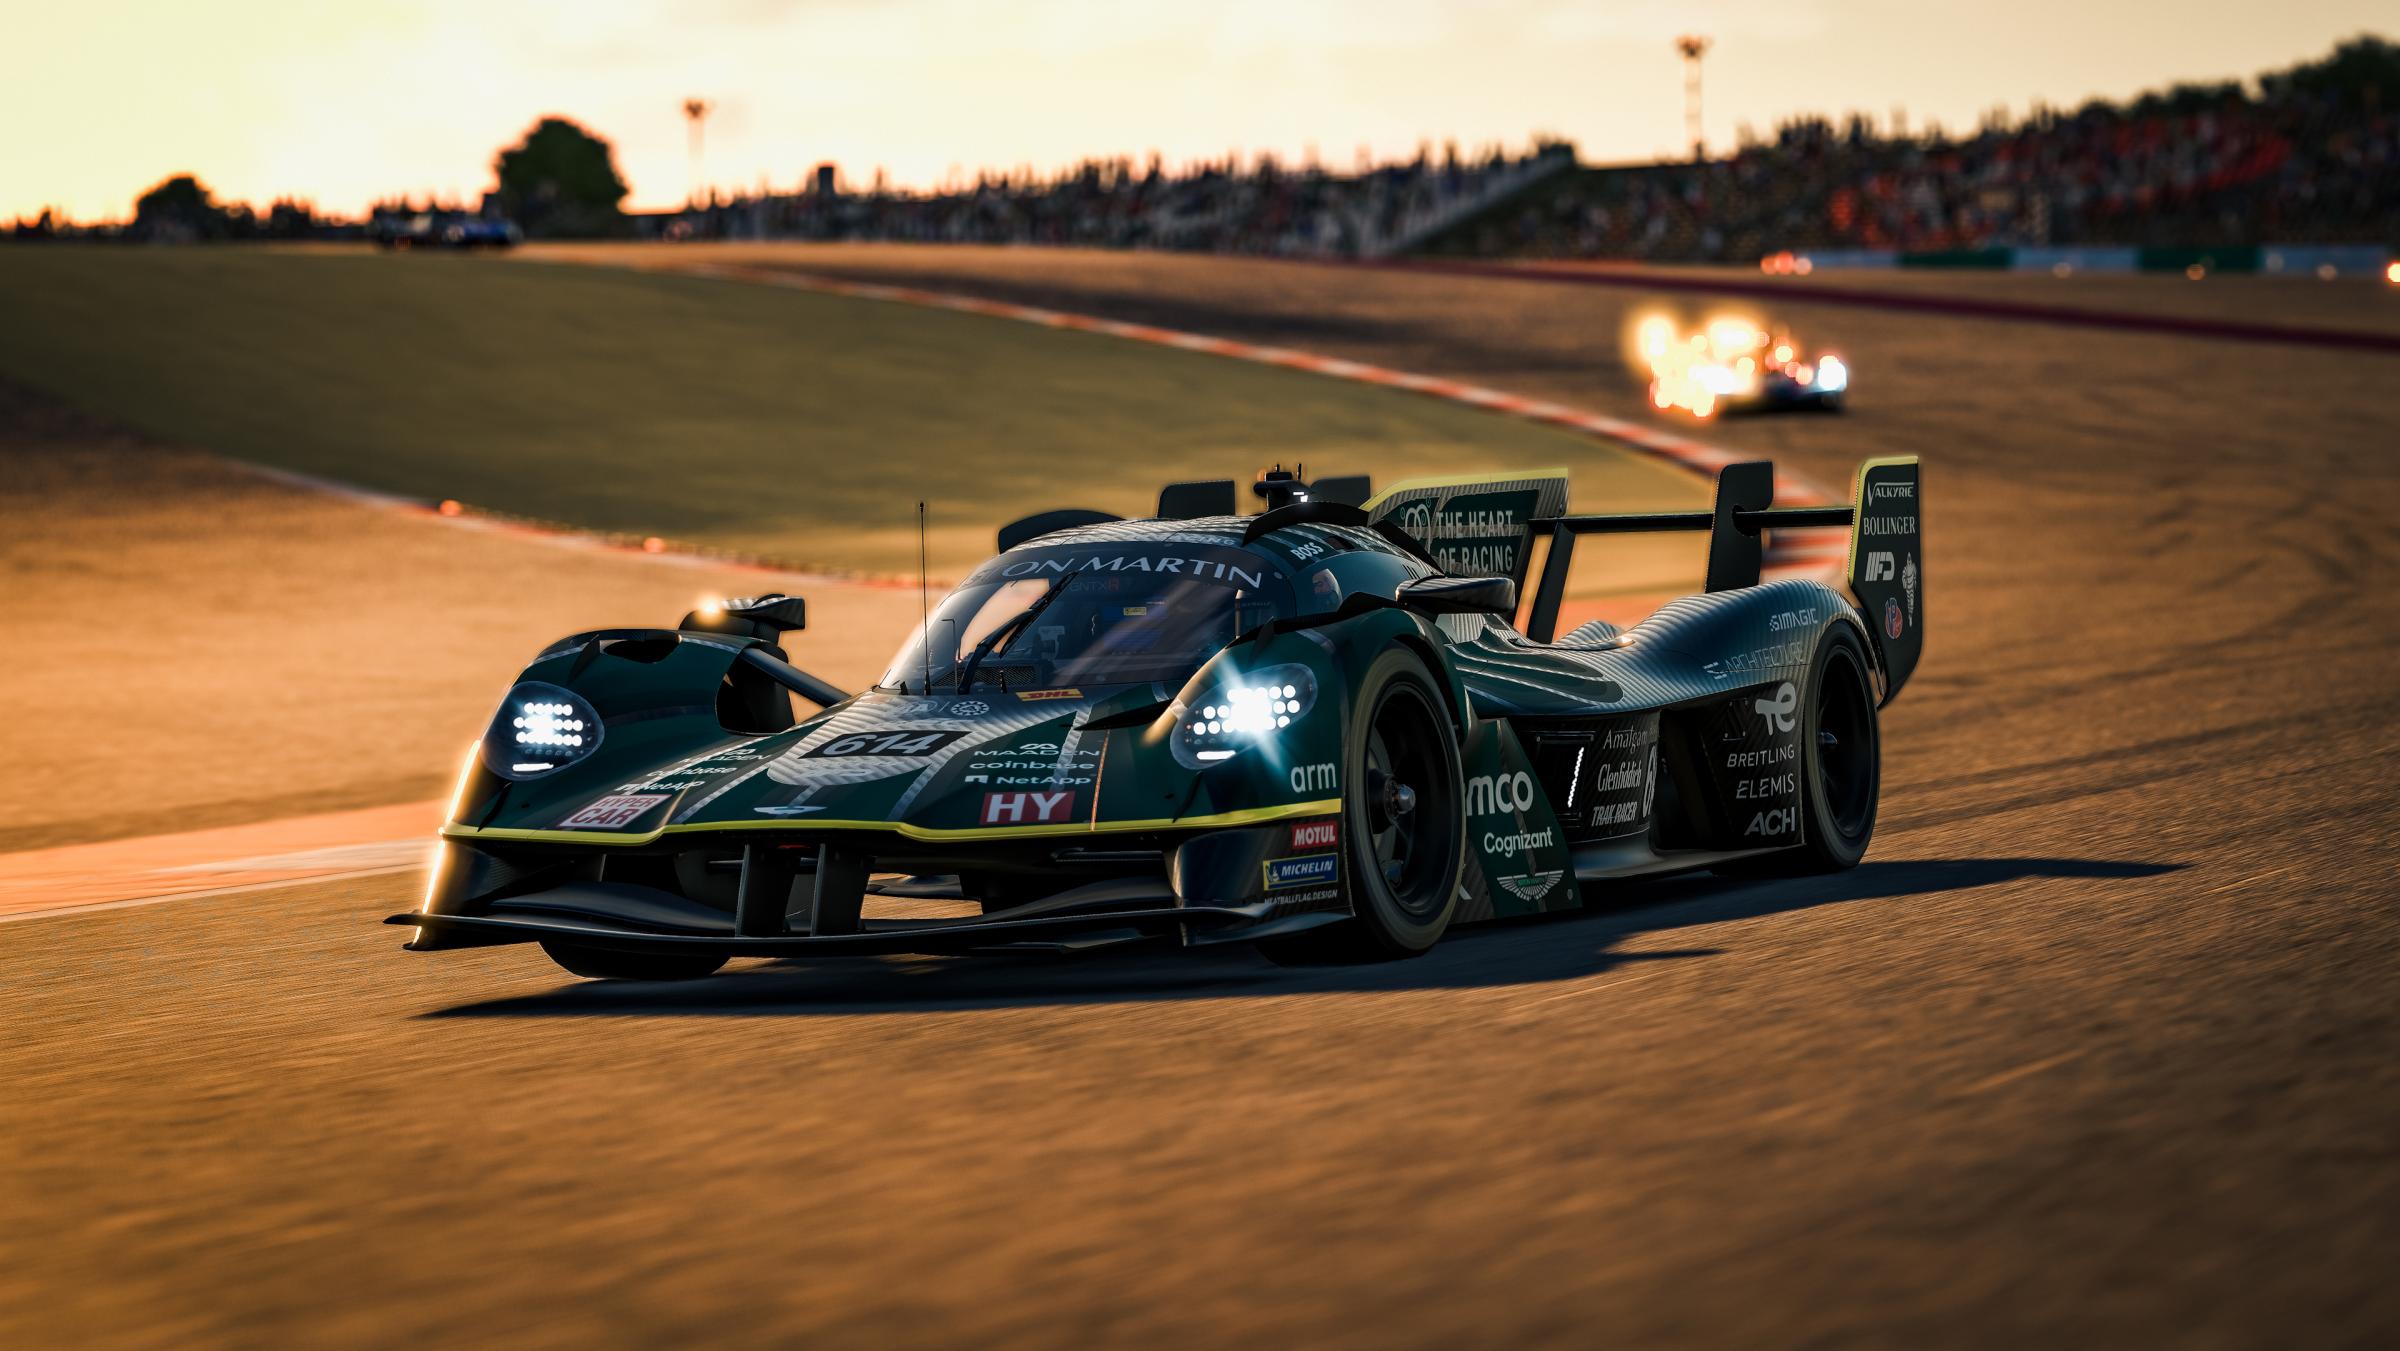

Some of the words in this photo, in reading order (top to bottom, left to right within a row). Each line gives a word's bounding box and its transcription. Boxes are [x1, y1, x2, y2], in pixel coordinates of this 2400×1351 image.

[1867, 481, 1914, 507] VALKYRIE
[1435, 510, 1464, 539] THE
[1468, 509, 1513, 538] HEART
[1863, 516, 1916, 536] BOLLINGER
[1290, 542, 1325, 560] BOSS
[1439, 546, 1457, 575] OF
[1462, 544, 1513, 574] RACING
[1078, 556, 1263, 589] MARTIN
[1769, 608, 1818, 631] SIMAGIC
[1724, 642, 1804, 671] ARCHITECTURE
[1027, 691, 1074, 699] DHL
[823, 733, 946, 756] 614
[1727, 743, 1795, 768] BREITLING
[969, 760, 1096, 769] coinbase
[1597, 759, 1642, 792] Glenfiddich
[996, 776, 1092, 785] NetApp
[1290, 762, 1337, 793] arm
[1736, 773, 1795, 799] ELEMIS
[595, 797, 657, 808] HYPER
[1466, 771, 1534, 817] mco
[571, 808, 640, 825] CAR
[986, 792, 1068, 823] HY
[1591, 804, 1616, 827] TRAK
[1744, 806, 1796, 836] ACH
[1294, 824, 1336, 847] MOTUL
[1483, 826, 1553, 858] Cognizant
[1281, 860, 1334, 877] MICHELIN
